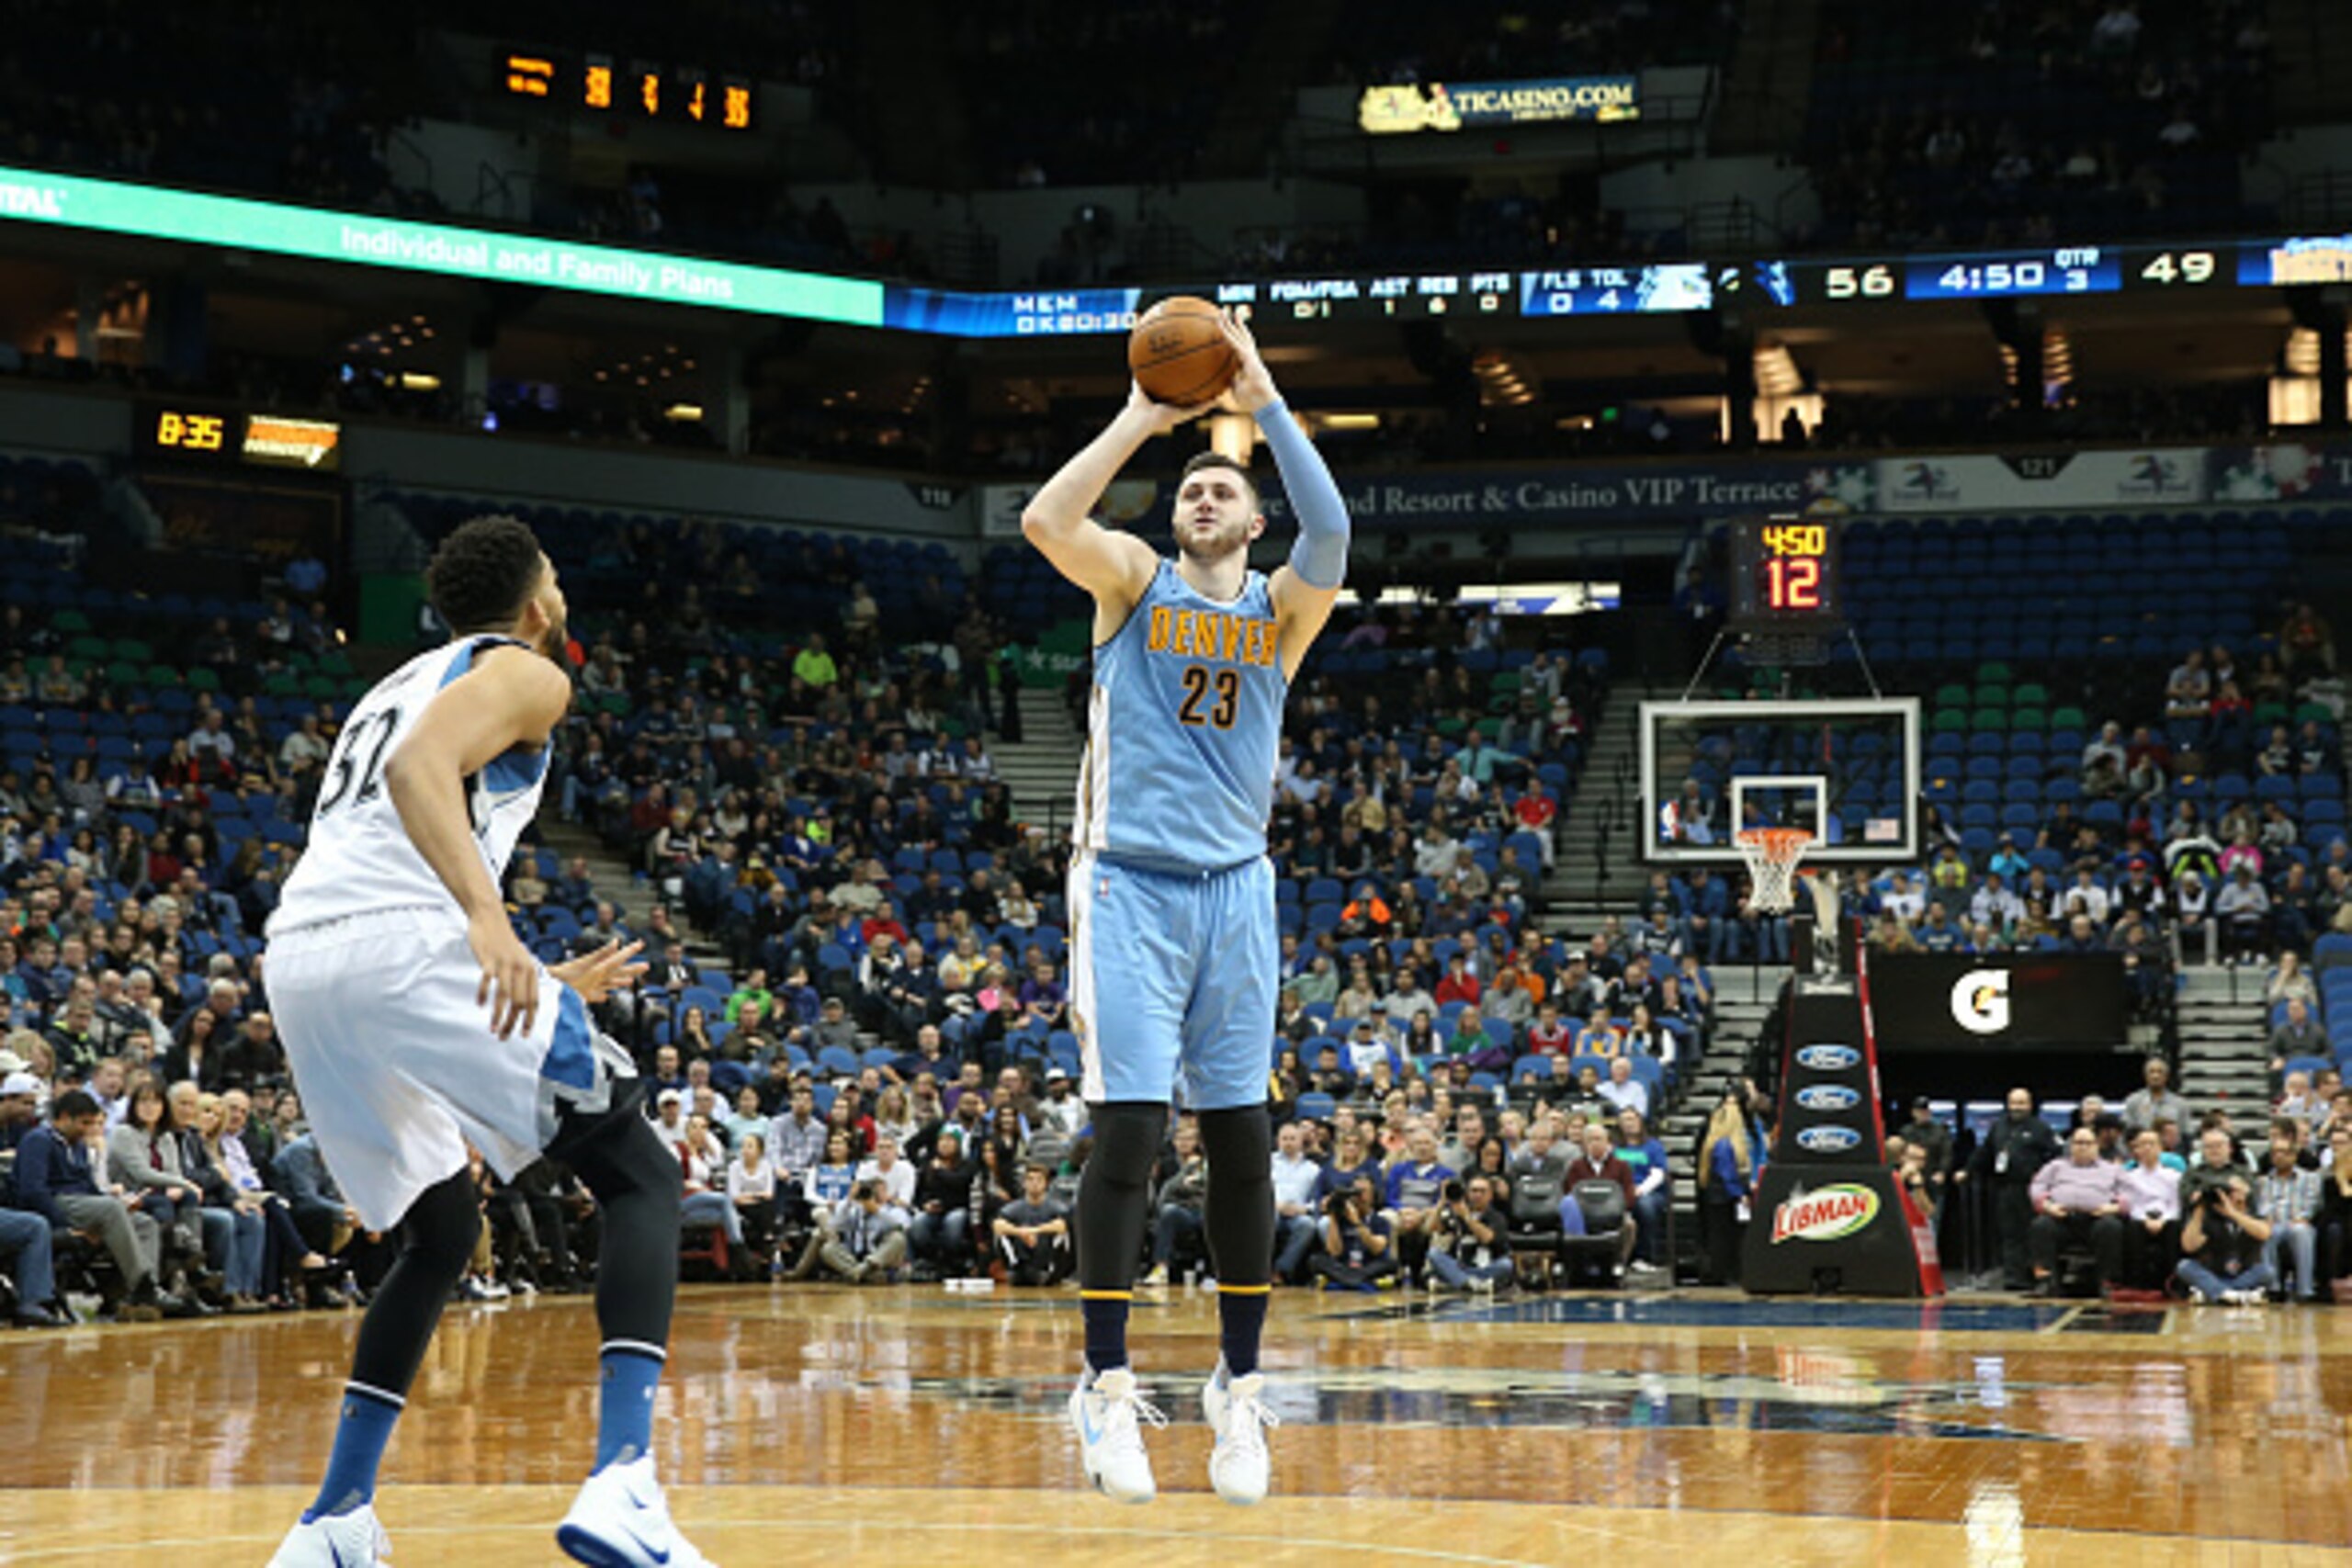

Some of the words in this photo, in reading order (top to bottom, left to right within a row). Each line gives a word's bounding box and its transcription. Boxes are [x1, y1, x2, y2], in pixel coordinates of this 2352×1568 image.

[340, 226, 488, 268] Individual
[496, 248, 550, 276] and
[559, 254, 652, 292] Family
[660, 266, 734, 299] Plans
[1825, 264, 1894, 299] 56
[1938, 261, 2045, 291] 4:50
[2053, 247, 2100, 268] QTR
[2064, 269, 2089, 291] 3
[2141, 251, 2215, 284] 49
[1548, 292, 1574, 314] 0
[1595, 288, 1622, 310] 4
[1384, 487, 1473, 513] Resort
[1481, 482, 1510, 512] &
[1517, 481, 1617, 511] Casino
[1623, 477, 1684, 506] VIP
[1690, 474, 1799, 504] Terrace
[1766, 557, 1820, 610] 12
[1147, 604, 1280, 669] DENVER
[1178, 663, 1239, 730] 23
[316, 702, 403, 820] 32
[1951, 968, 2010, 1034] G
[1771, 1193, 1870, 1240] LIBMAN
